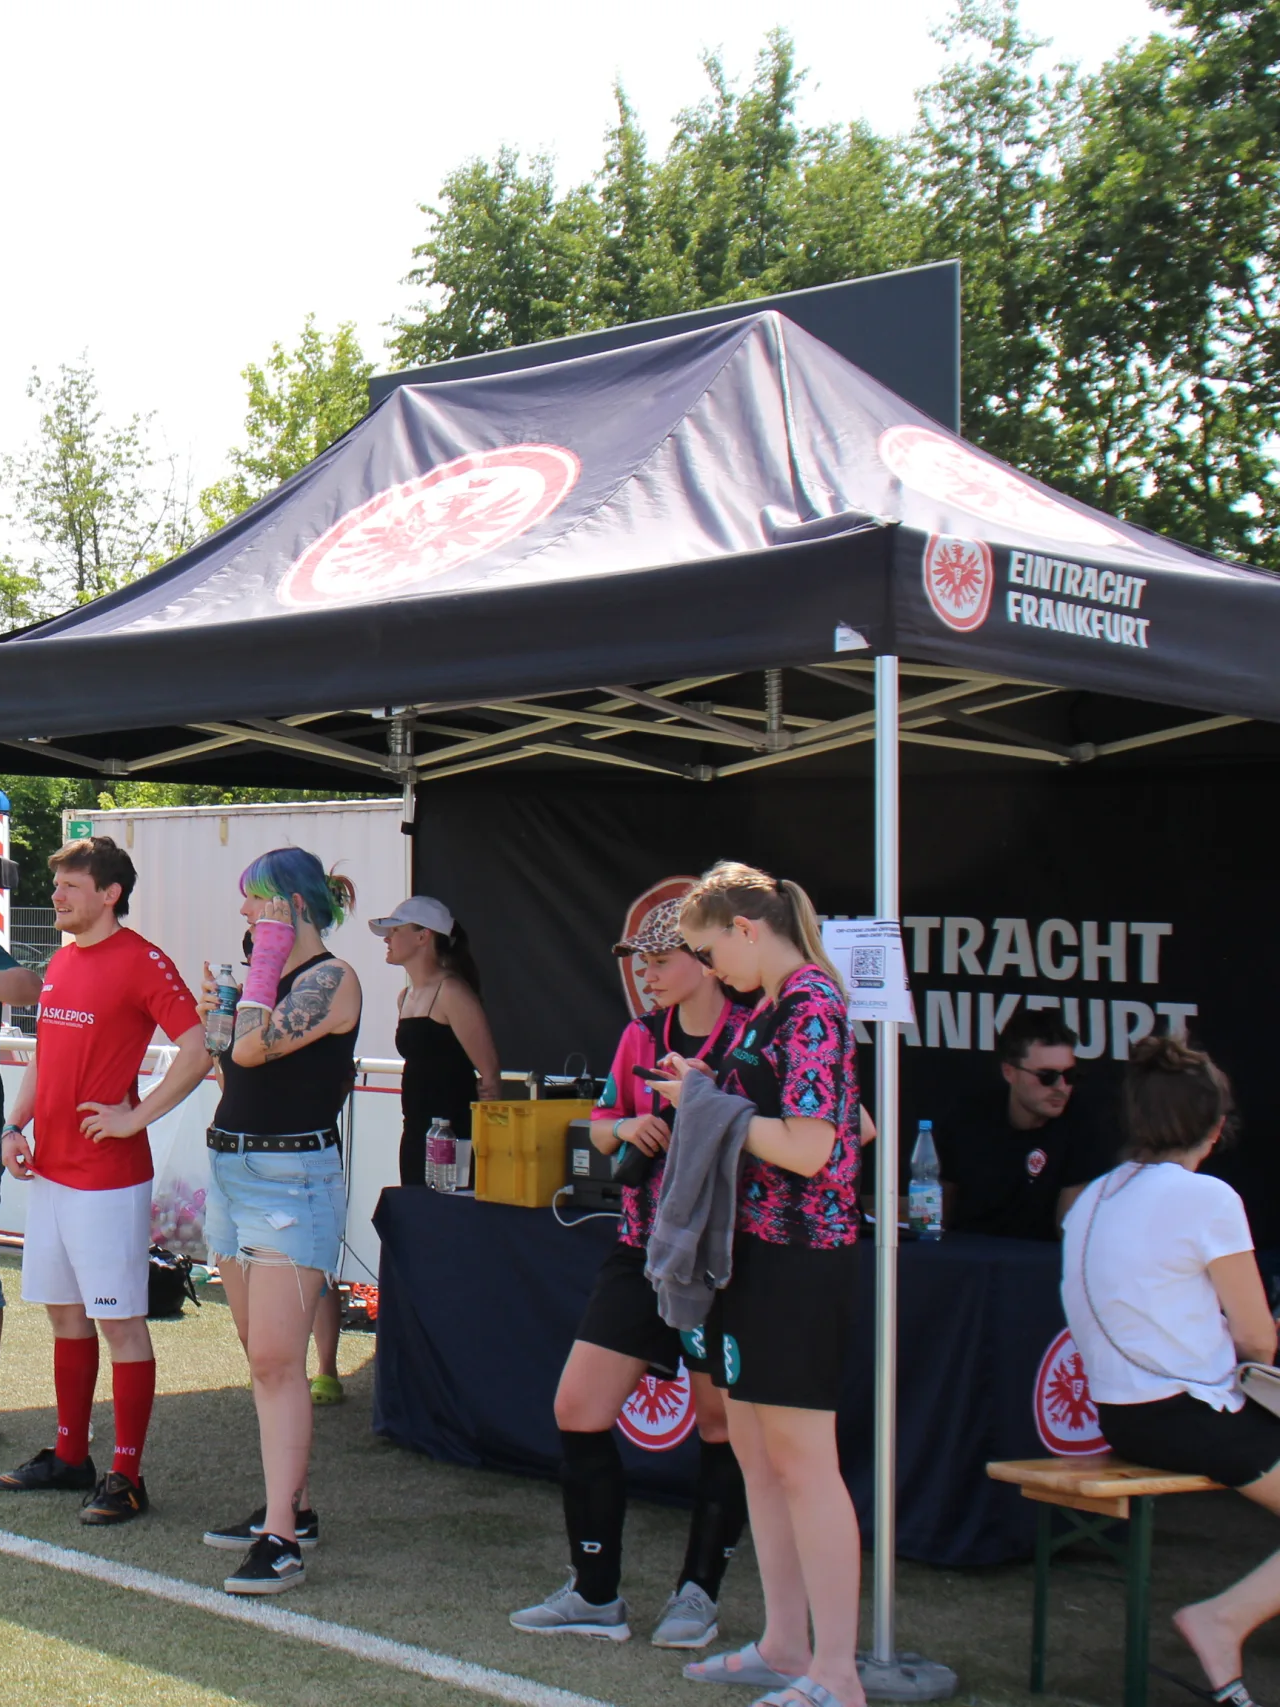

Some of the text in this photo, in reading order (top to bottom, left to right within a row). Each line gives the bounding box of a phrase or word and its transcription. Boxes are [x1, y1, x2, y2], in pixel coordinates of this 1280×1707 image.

[1007, 550, 1148, 610] EINTRACHT
[1006, 590, 1151, 649] FRANKFURT
[816, 914, 1174, 985] TRACHT
[42, 1006, 95, 1025] ASKLEPIOS
[94, 1297, 118, 1306] JAKO
